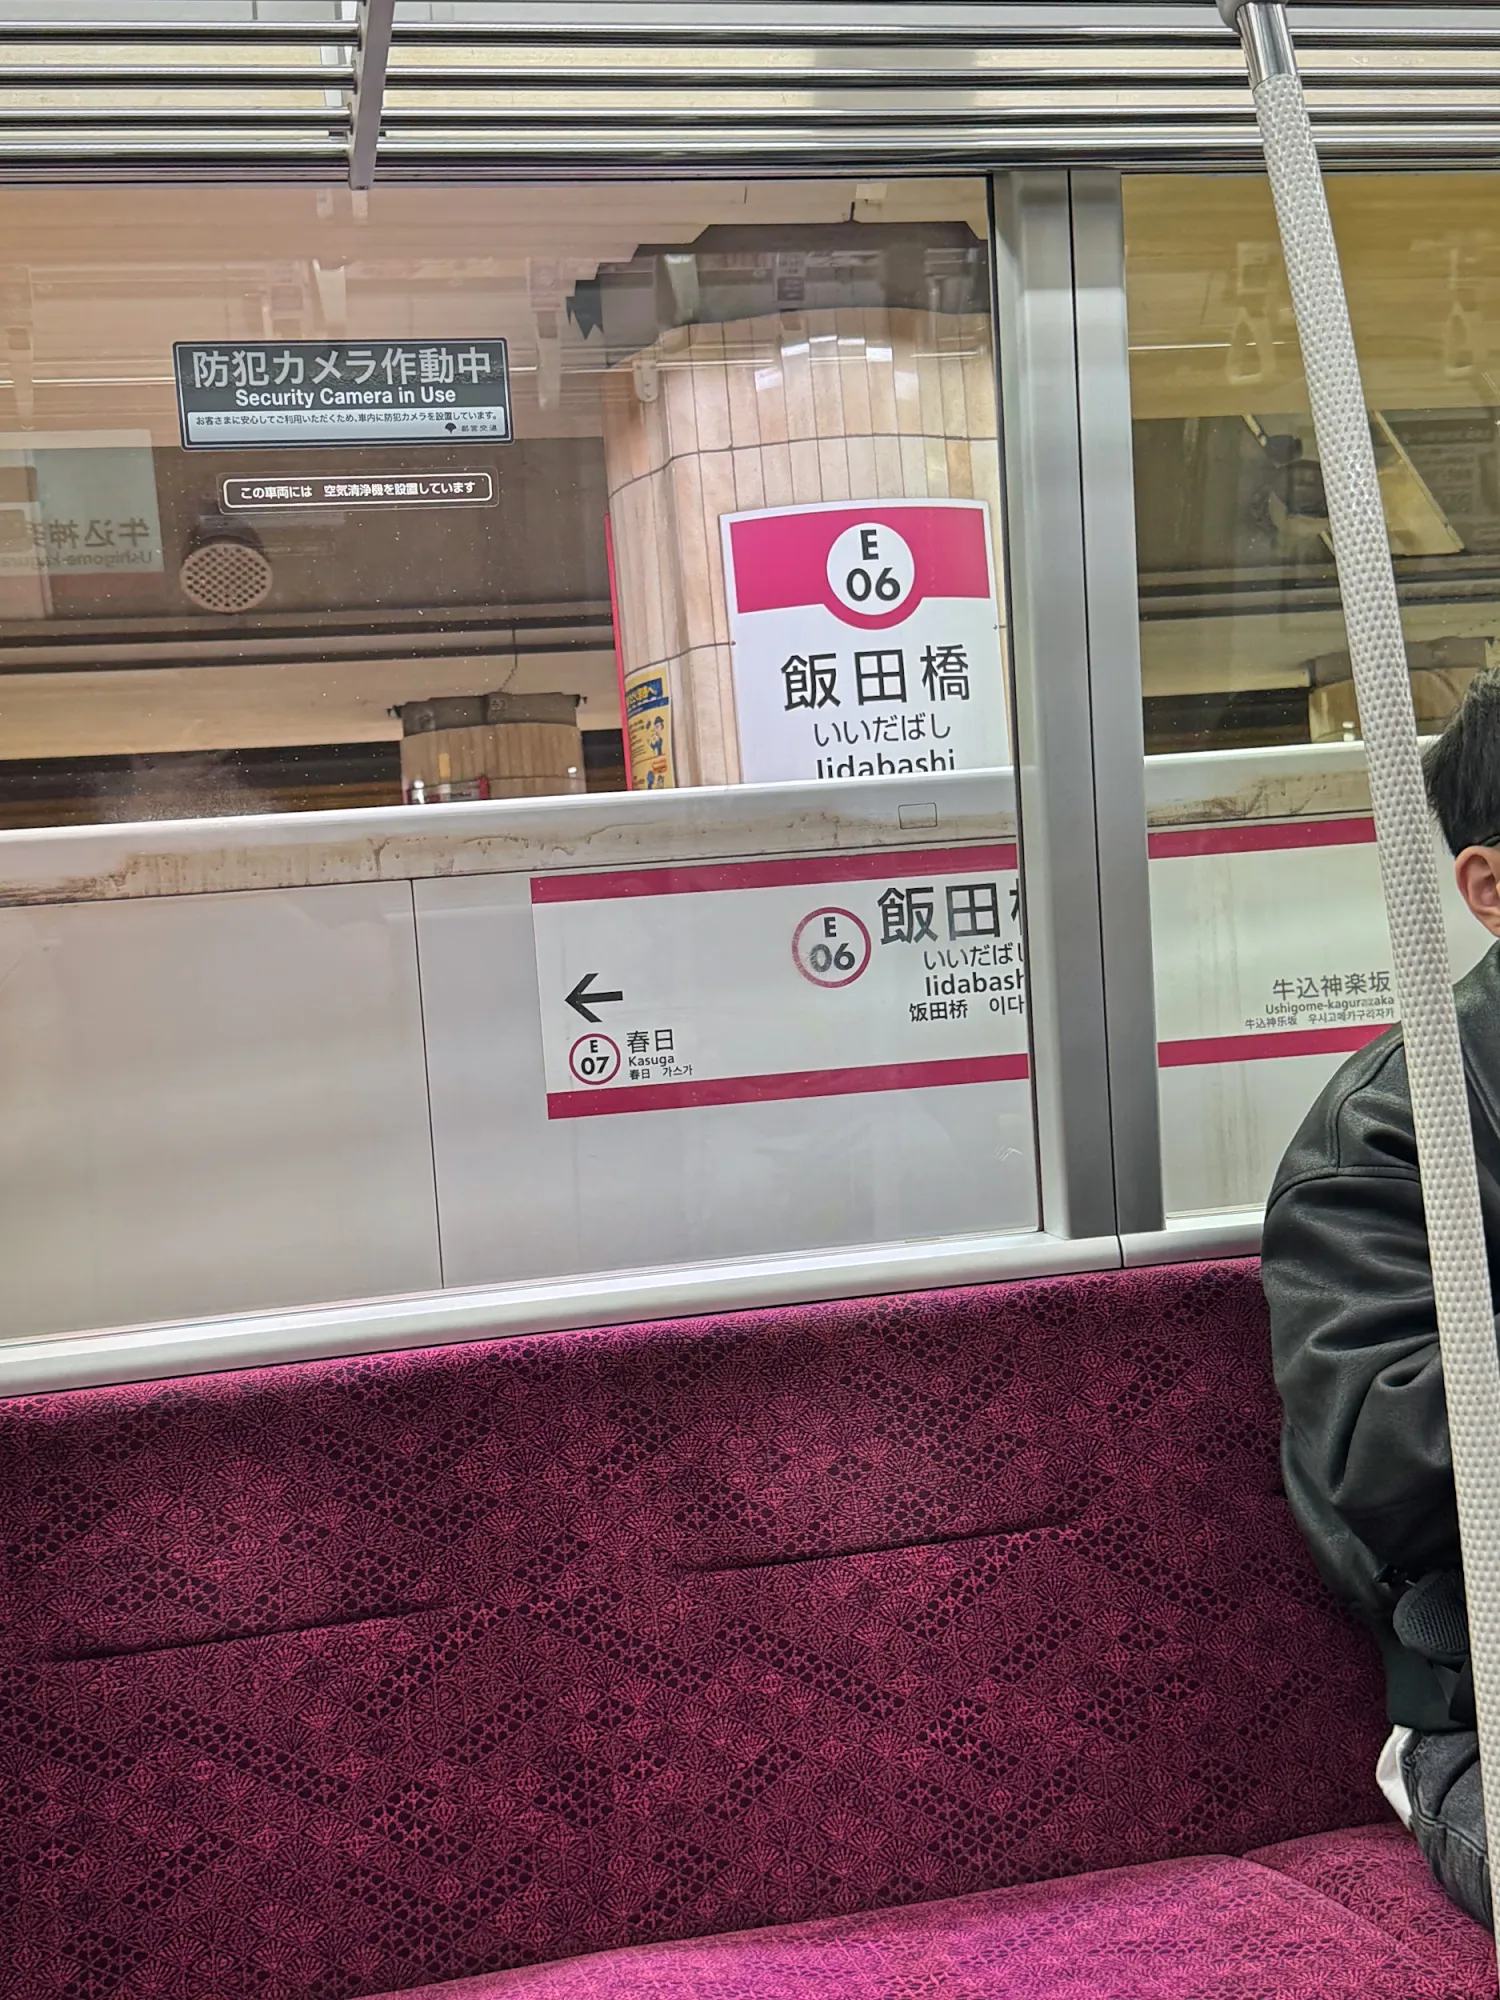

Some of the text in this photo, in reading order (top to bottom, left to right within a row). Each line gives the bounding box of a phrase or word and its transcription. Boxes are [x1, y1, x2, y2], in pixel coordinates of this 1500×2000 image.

[193, 346, 491, 388] 防犯カメラ作動中
[235, 386, 457, 409] Security Camera in Use
[241, 481, 476, 500] この車両には 空気清浄機を設置しています
[859, 529, 879, 561] E
[846, 567, 901, 602] 06
[780, 644, 970, 712] 飯田橋
[813, 712, 951, 748] いいだばし
[823, 916, 837, 938] E
[809, 942, 856, 973] 06
[1272, 971, 1392, 1001] 牛込神楽坂
[909, 999, 969, 1023] 饭田桥
[1265, 995, 1395, 1016] Ushigome-kagurazaka
[589, 1040, 599, 1054] E
[626, 1028, 675, 1055] 春日
[580, 1055, 610, 1076] 07
[628, 1054, 675, 1068] Kasuga
[662, 1064, 693, 1079] 가스가
[629, 1068, 651, 1081] 春日
